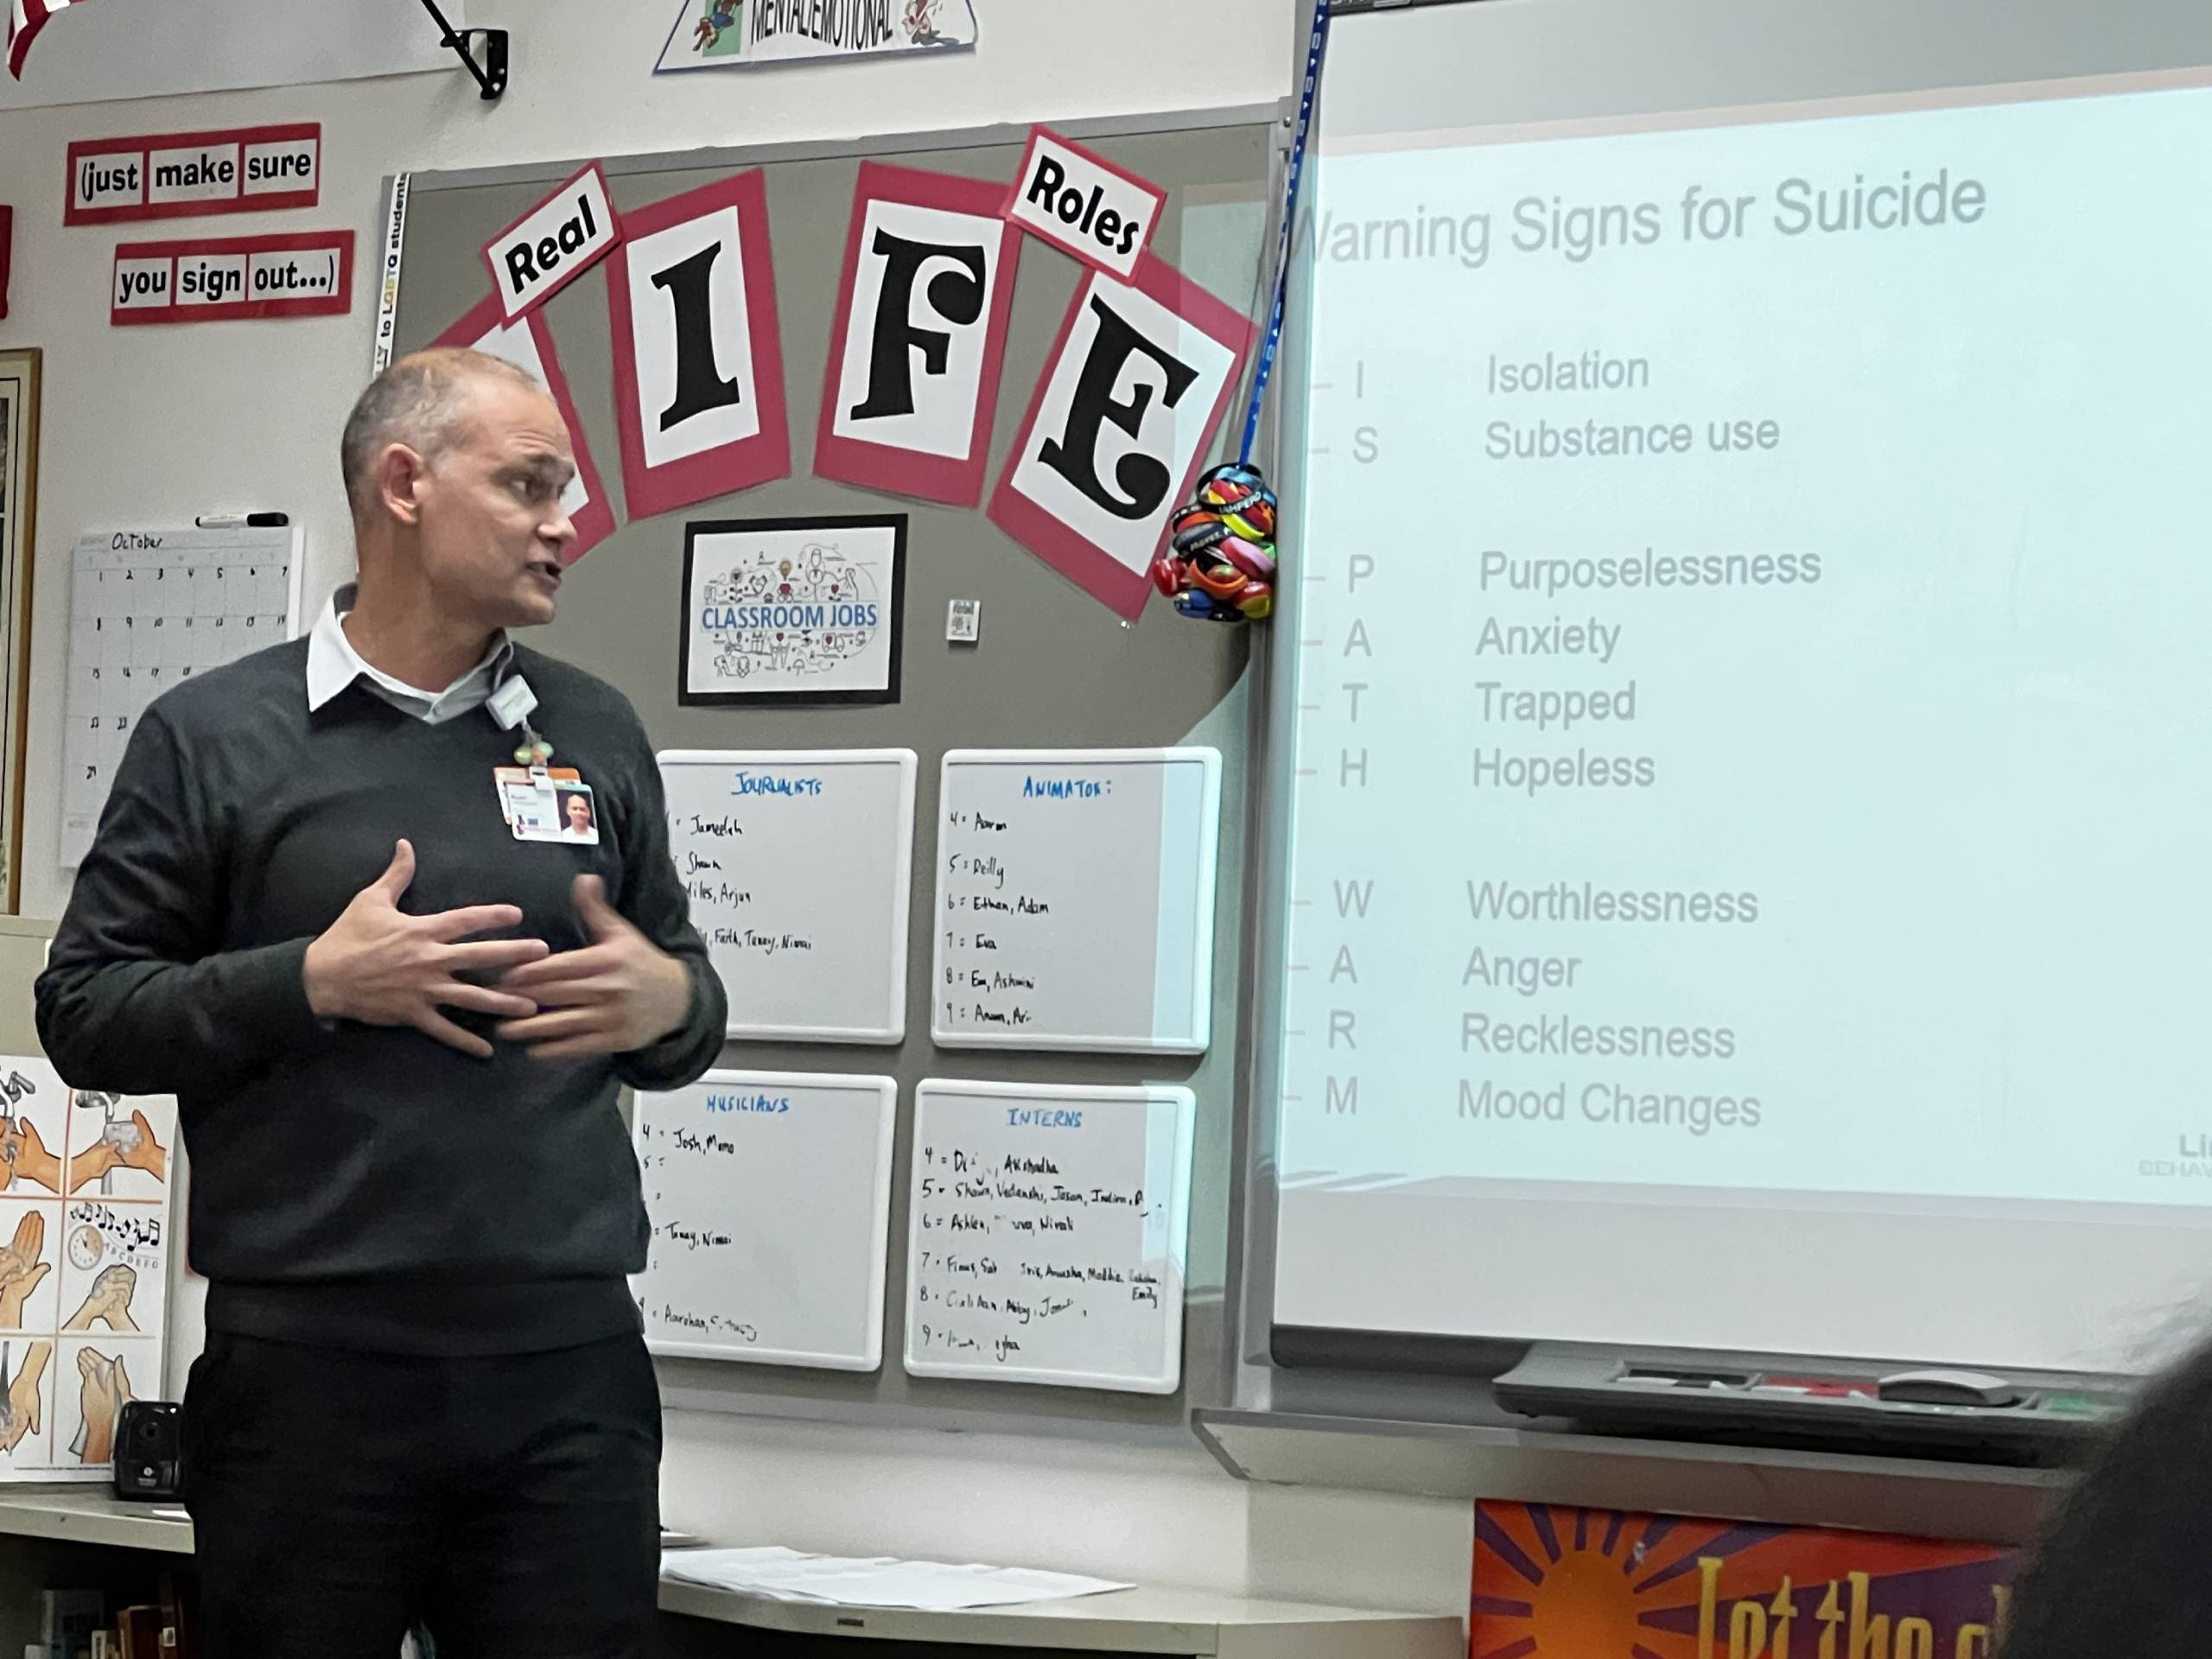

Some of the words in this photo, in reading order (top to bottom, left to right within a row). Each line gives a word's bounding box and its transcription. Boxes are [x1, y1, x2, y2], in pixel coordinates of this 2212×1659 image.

[82, 162, 138, 201] (just
[156, 154, 234, 188] make
[248, 153, 311, 180] sure
[1027, 155, 1139, 255] Roles
[1511, 195, 1662, 264] Signs
[1680, 184, 1756, 241] for
[1774, 167, 1986, 236] Suicide
[505, 193, 597, 295] Real
[119, 270, 167, 303] you
[182, 262, 240, 301] sign
[254, 255, 334, 294] out...)
[382, 255, 398, 315] LGBTQ
[380, 321, 391, 337] to
[1488, 350, 1649, 395] Isolation
[1352, 426, 1380, 464] S
[1485, 419, 1693, 461] Substance
[1707, 418, 1780, 450] use
[111, 531, 162, 550] October
[125, 570, 134, 581] 2
[1348, 554, 1375, 593] P
[1480, 547, 1822, 599] Purposelessness
[702, 605, 822, 630] CLASSROOM
[830, 603, 878, 628] JOBS
[1343, 618, 1373, 657] A
[1475, 615, 1621, 664] Anxiety
[1342, 683, 1369, 722] T
[1475, 680, 1637, 732] Trapped
[731, 771, 823, 797] JOURNALISTS
[1340, 748, 1369, 787] H
[1473, 747, 1656, 798] Hopeless
[1334, 880, 1375, 918] W
[1467, 880, 1759, 924] Worthlessness
[1329, 944, 1358, 984] A
[1462, 945, 1582, 997] Anger
[1329, 1009, 1357, 1050] R
[1461, 1012, 1736, 1060] Recklessness
[706, 1094, 789, 1113] MUSICIANS
[1007, 1108, 1082, 1128] INTERNS
[1325, 1075, 1358, 1116] M
[1459, 1078, 1566, 1121] Mood
[1580, 1082, 1762, 1137] Changes
[925, 1147, 932, 1165] 4
[922, 1178, 935, 1198] 5
[923, 1213, 931, 1229] 6
[920, 1285, 929, 1301] 8
